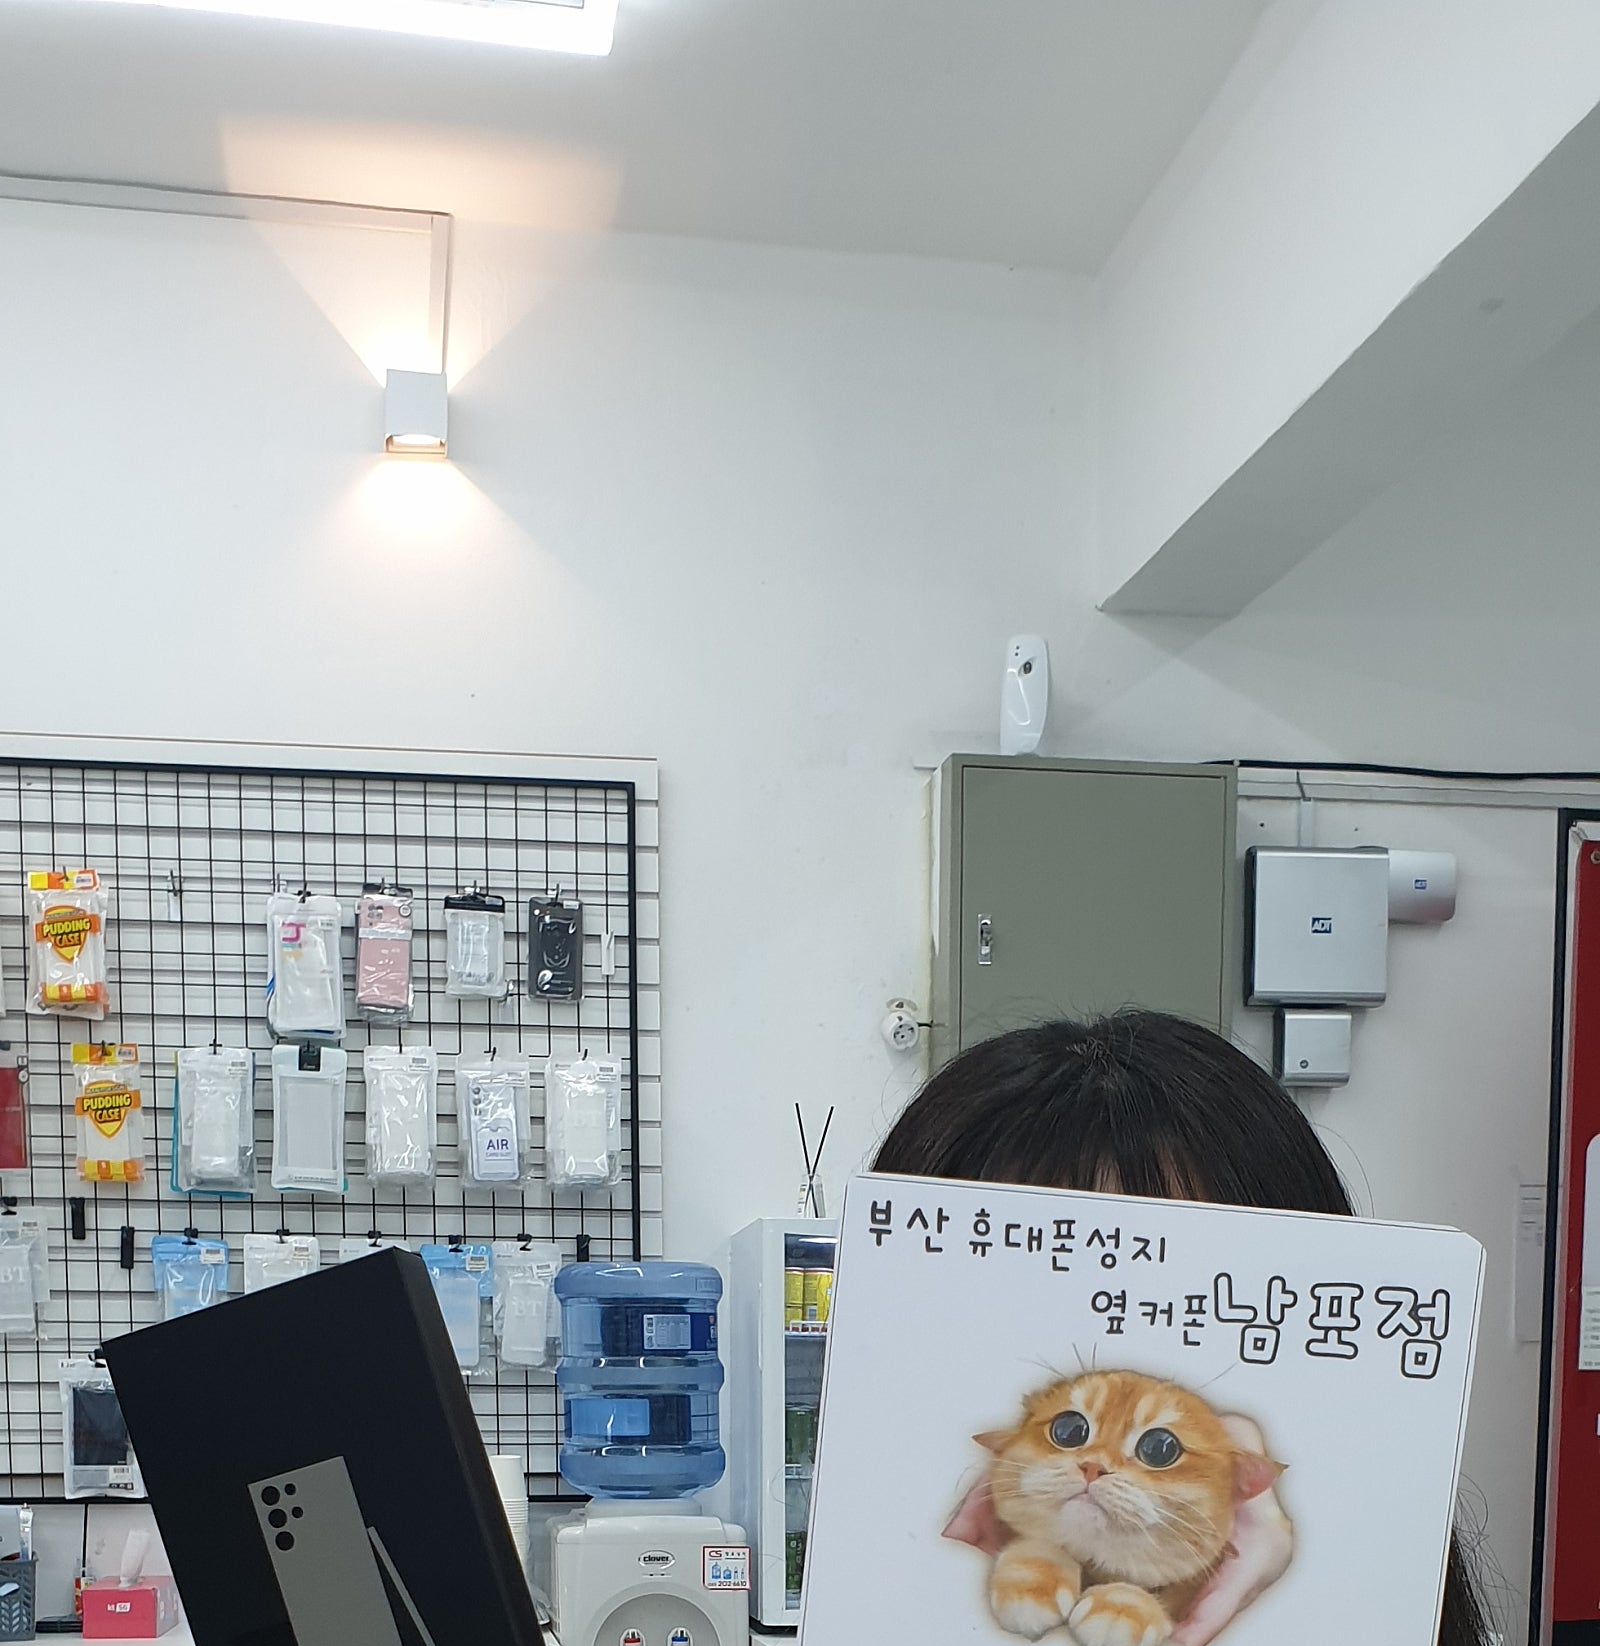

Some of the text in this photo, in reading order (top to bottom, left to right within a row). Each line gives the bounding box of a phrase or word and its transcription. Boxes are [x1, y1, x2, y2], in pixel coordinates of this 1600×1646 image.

[43, 919, 90, 936] PUDDING
[1311, 917, 1332, 933] ADT
[56, 933, 80, 946] CASE
[83, 1094, 131, 1111] PUDDING
[95, 1109, 120, 1121] CASE
[486, 1138, 509, 1150] AIR
[869, 1201, 1165, 1271] 부산 휴대폰성지
[643, 1554, 669, 1562] clover
